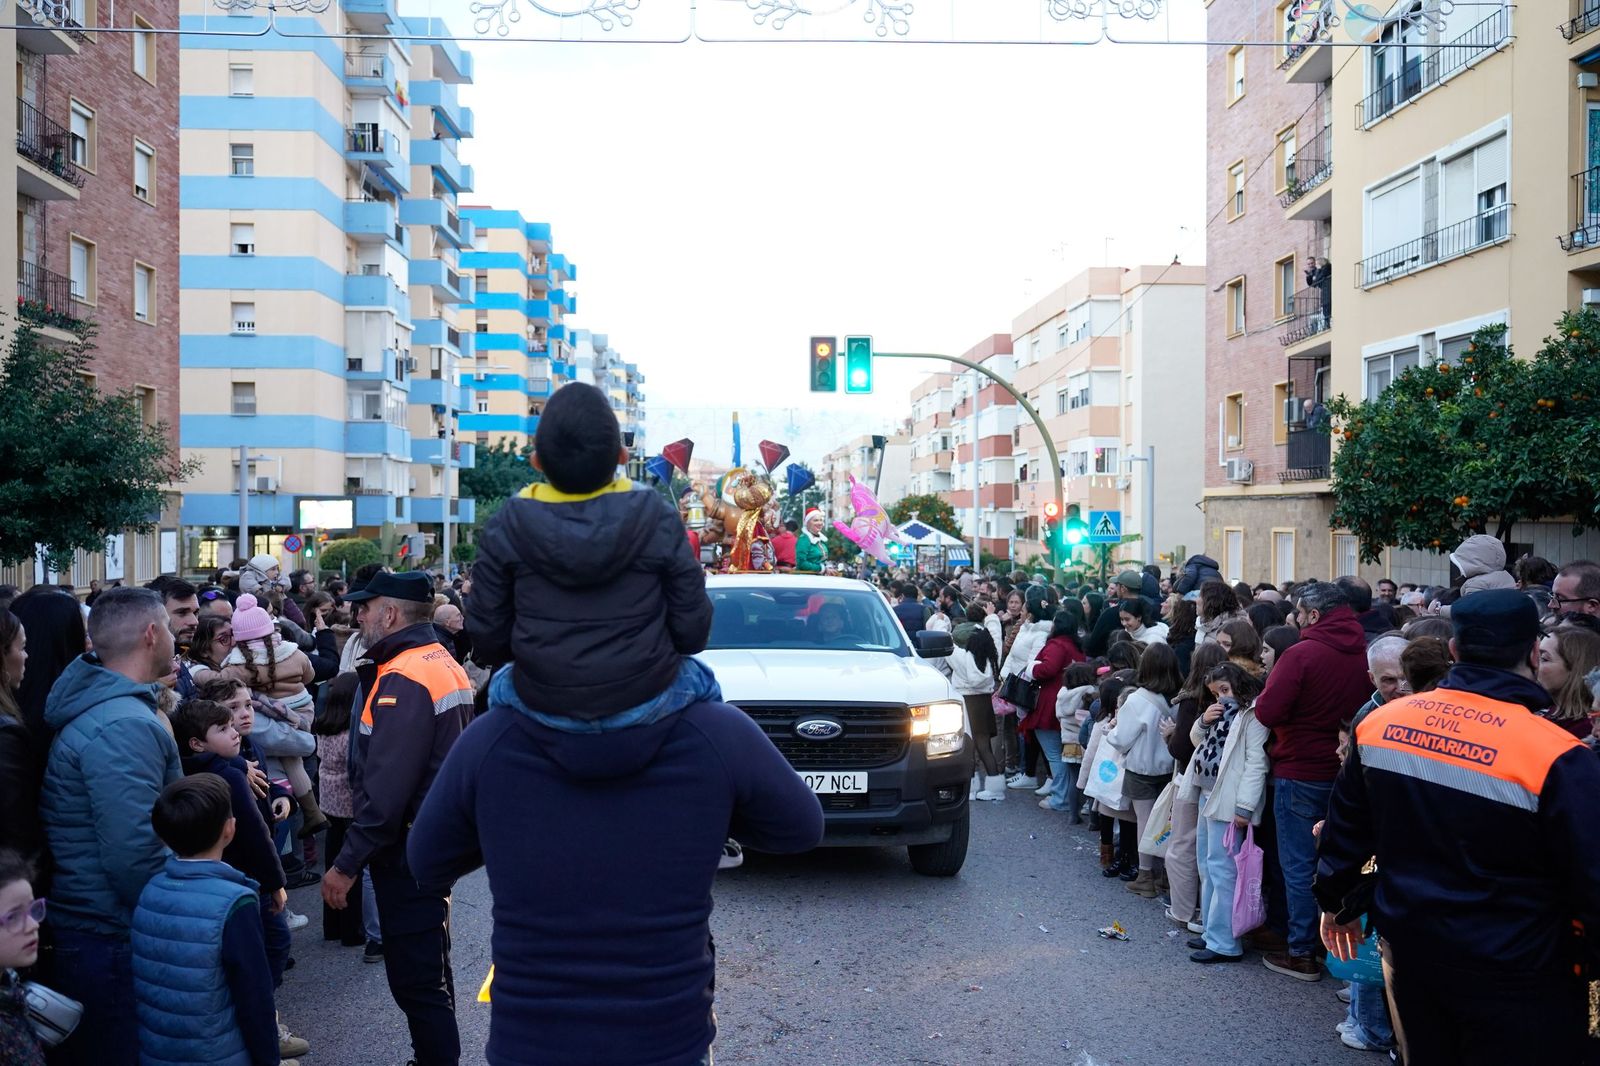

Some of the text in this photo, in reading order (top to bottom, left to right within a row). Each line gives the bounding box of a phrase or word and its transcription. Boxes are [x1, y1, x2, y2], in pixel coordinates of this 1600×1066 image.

[1407, 699, 1507, 728] PROTECCIÓN
[807, 723, 831, 735] Ford
[1425, 715, 1462, 733] CIVIL
[1385, 725, 1495, 764] VOLUNTARIADO
[831, 775, 862, 790] NCL
